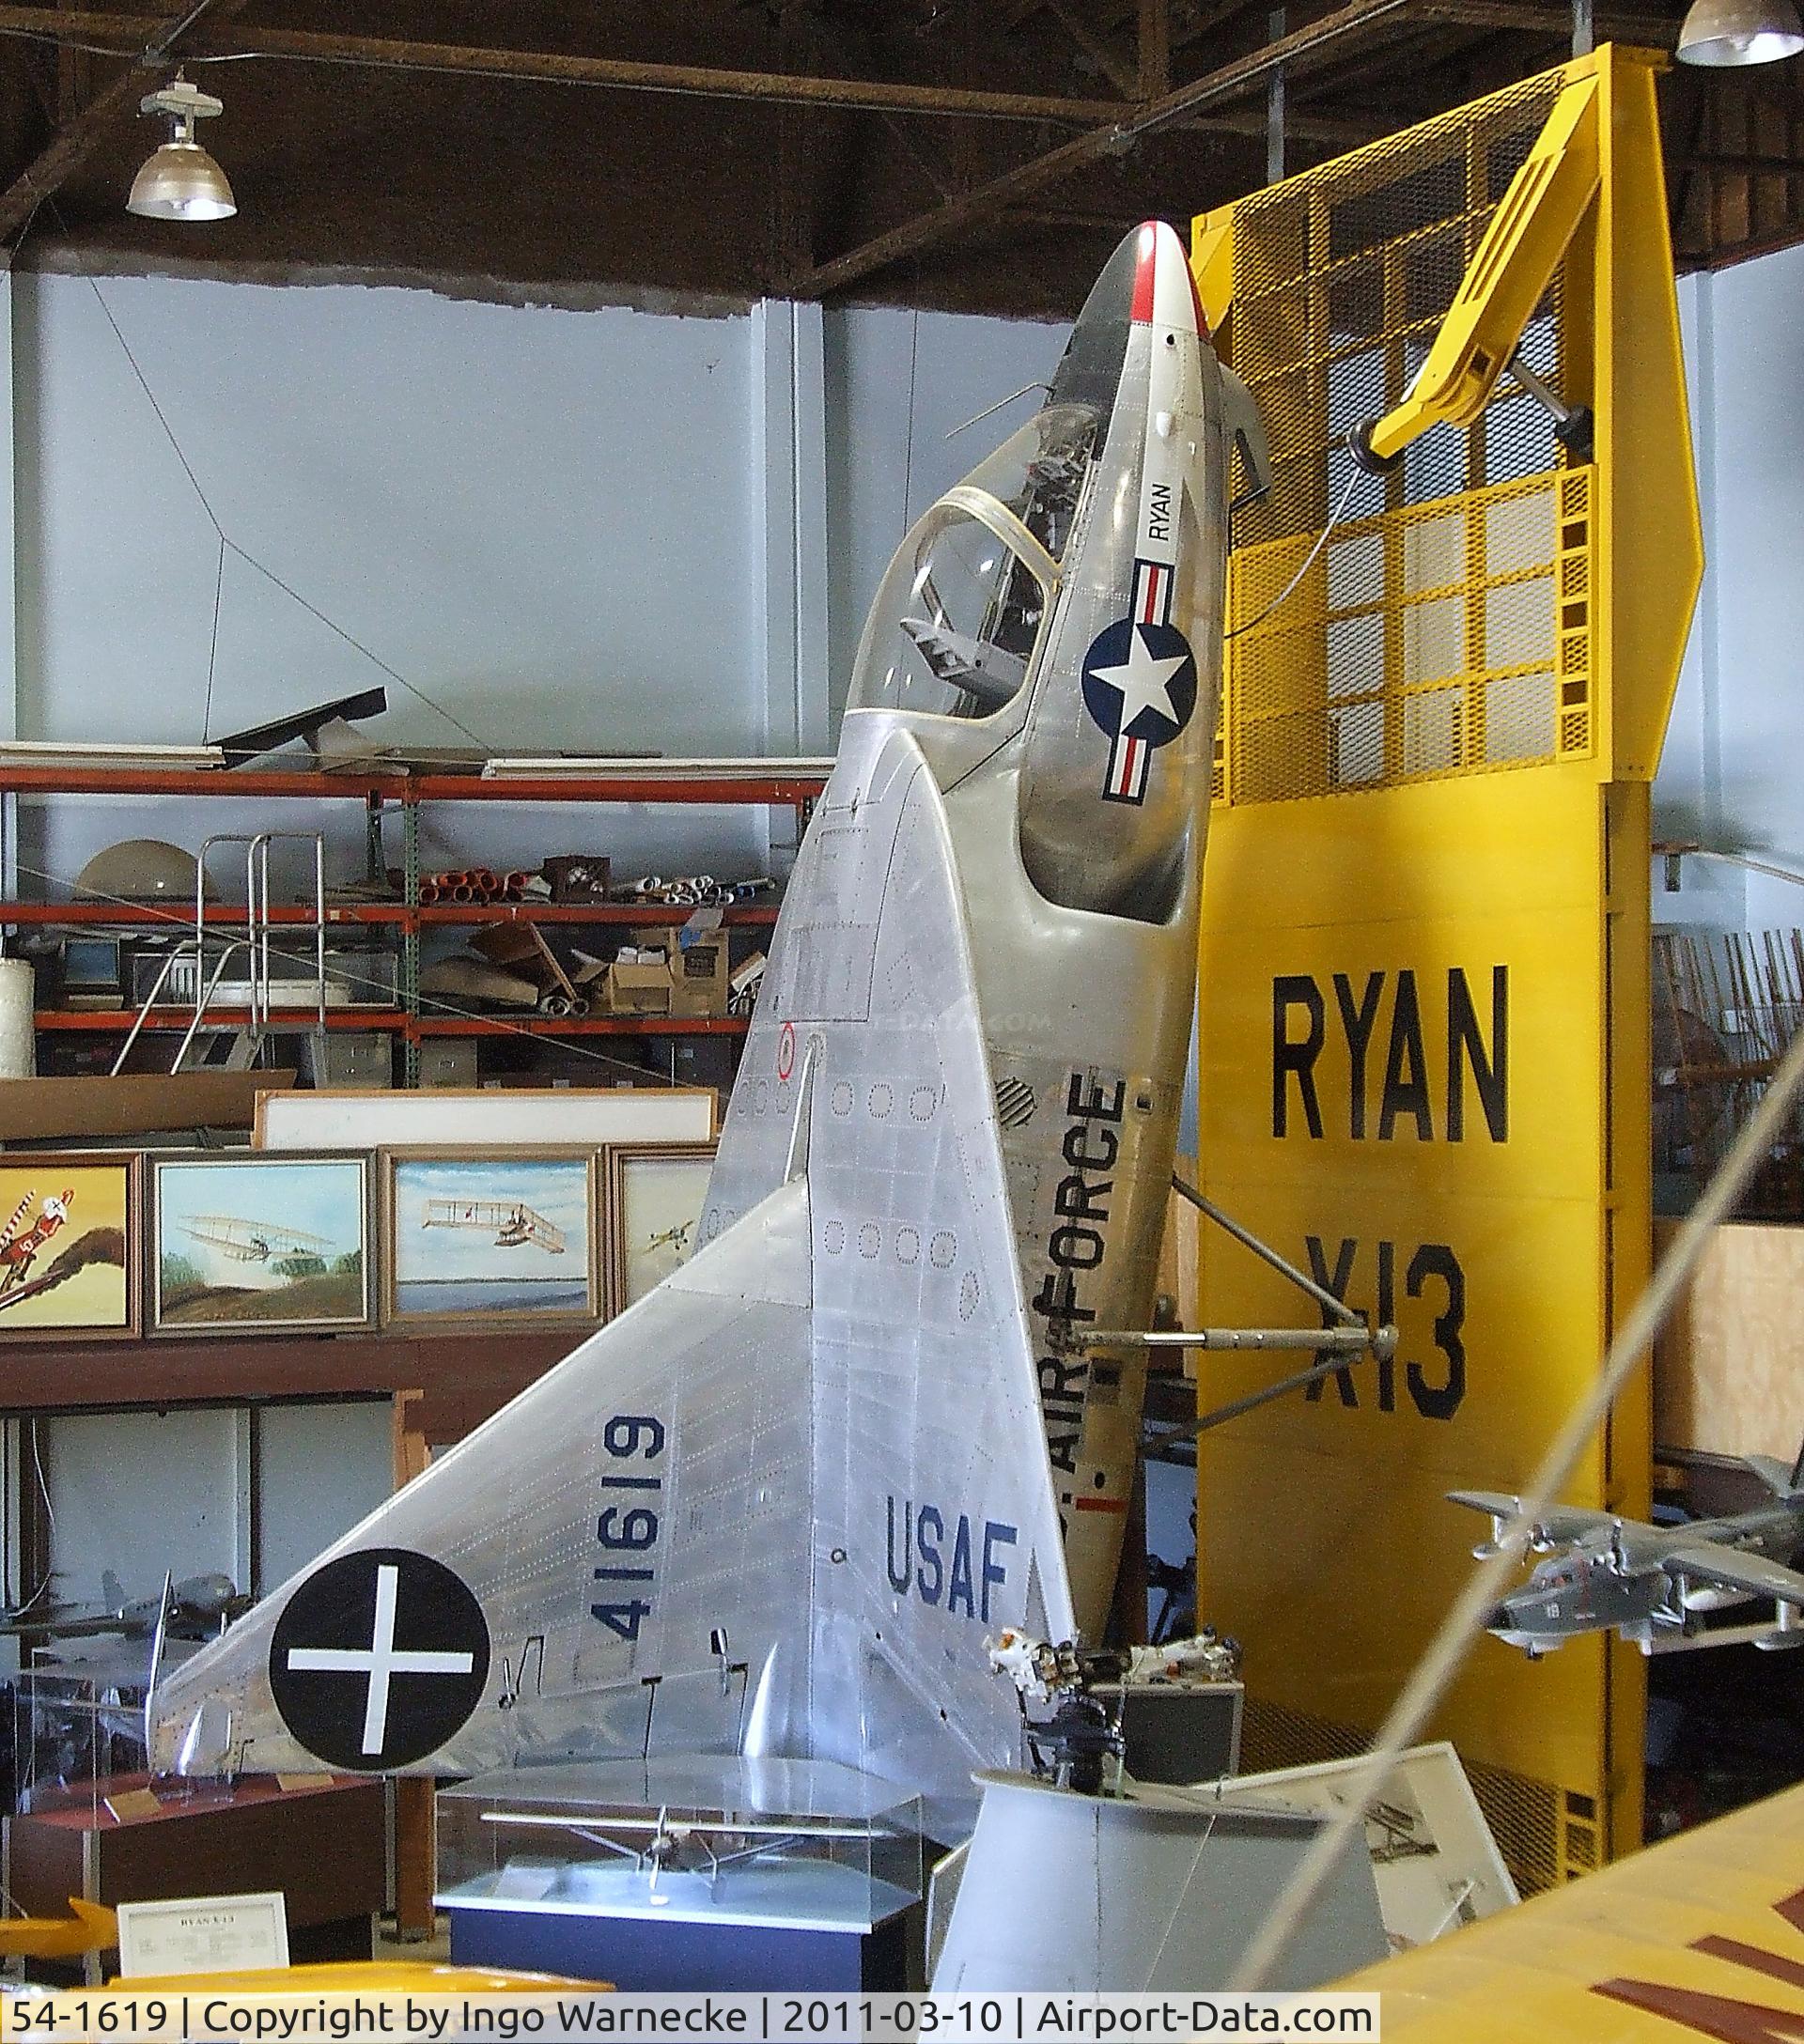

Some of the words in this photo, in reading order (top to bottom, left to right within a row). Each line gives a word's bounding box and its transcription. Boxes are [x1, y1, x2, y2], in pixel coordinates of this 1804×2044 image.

[1148, 483, 1172, 541] RYAN
[1272, 965, 1510, 1142] RYAN
[1041, 1072, 1127, 1323] FORCE
[1036, 1355, 1091, 1475] AIR
[590, 1416, 665, 1641] 41619
[887, 1494, 1019, 1623] USAF
